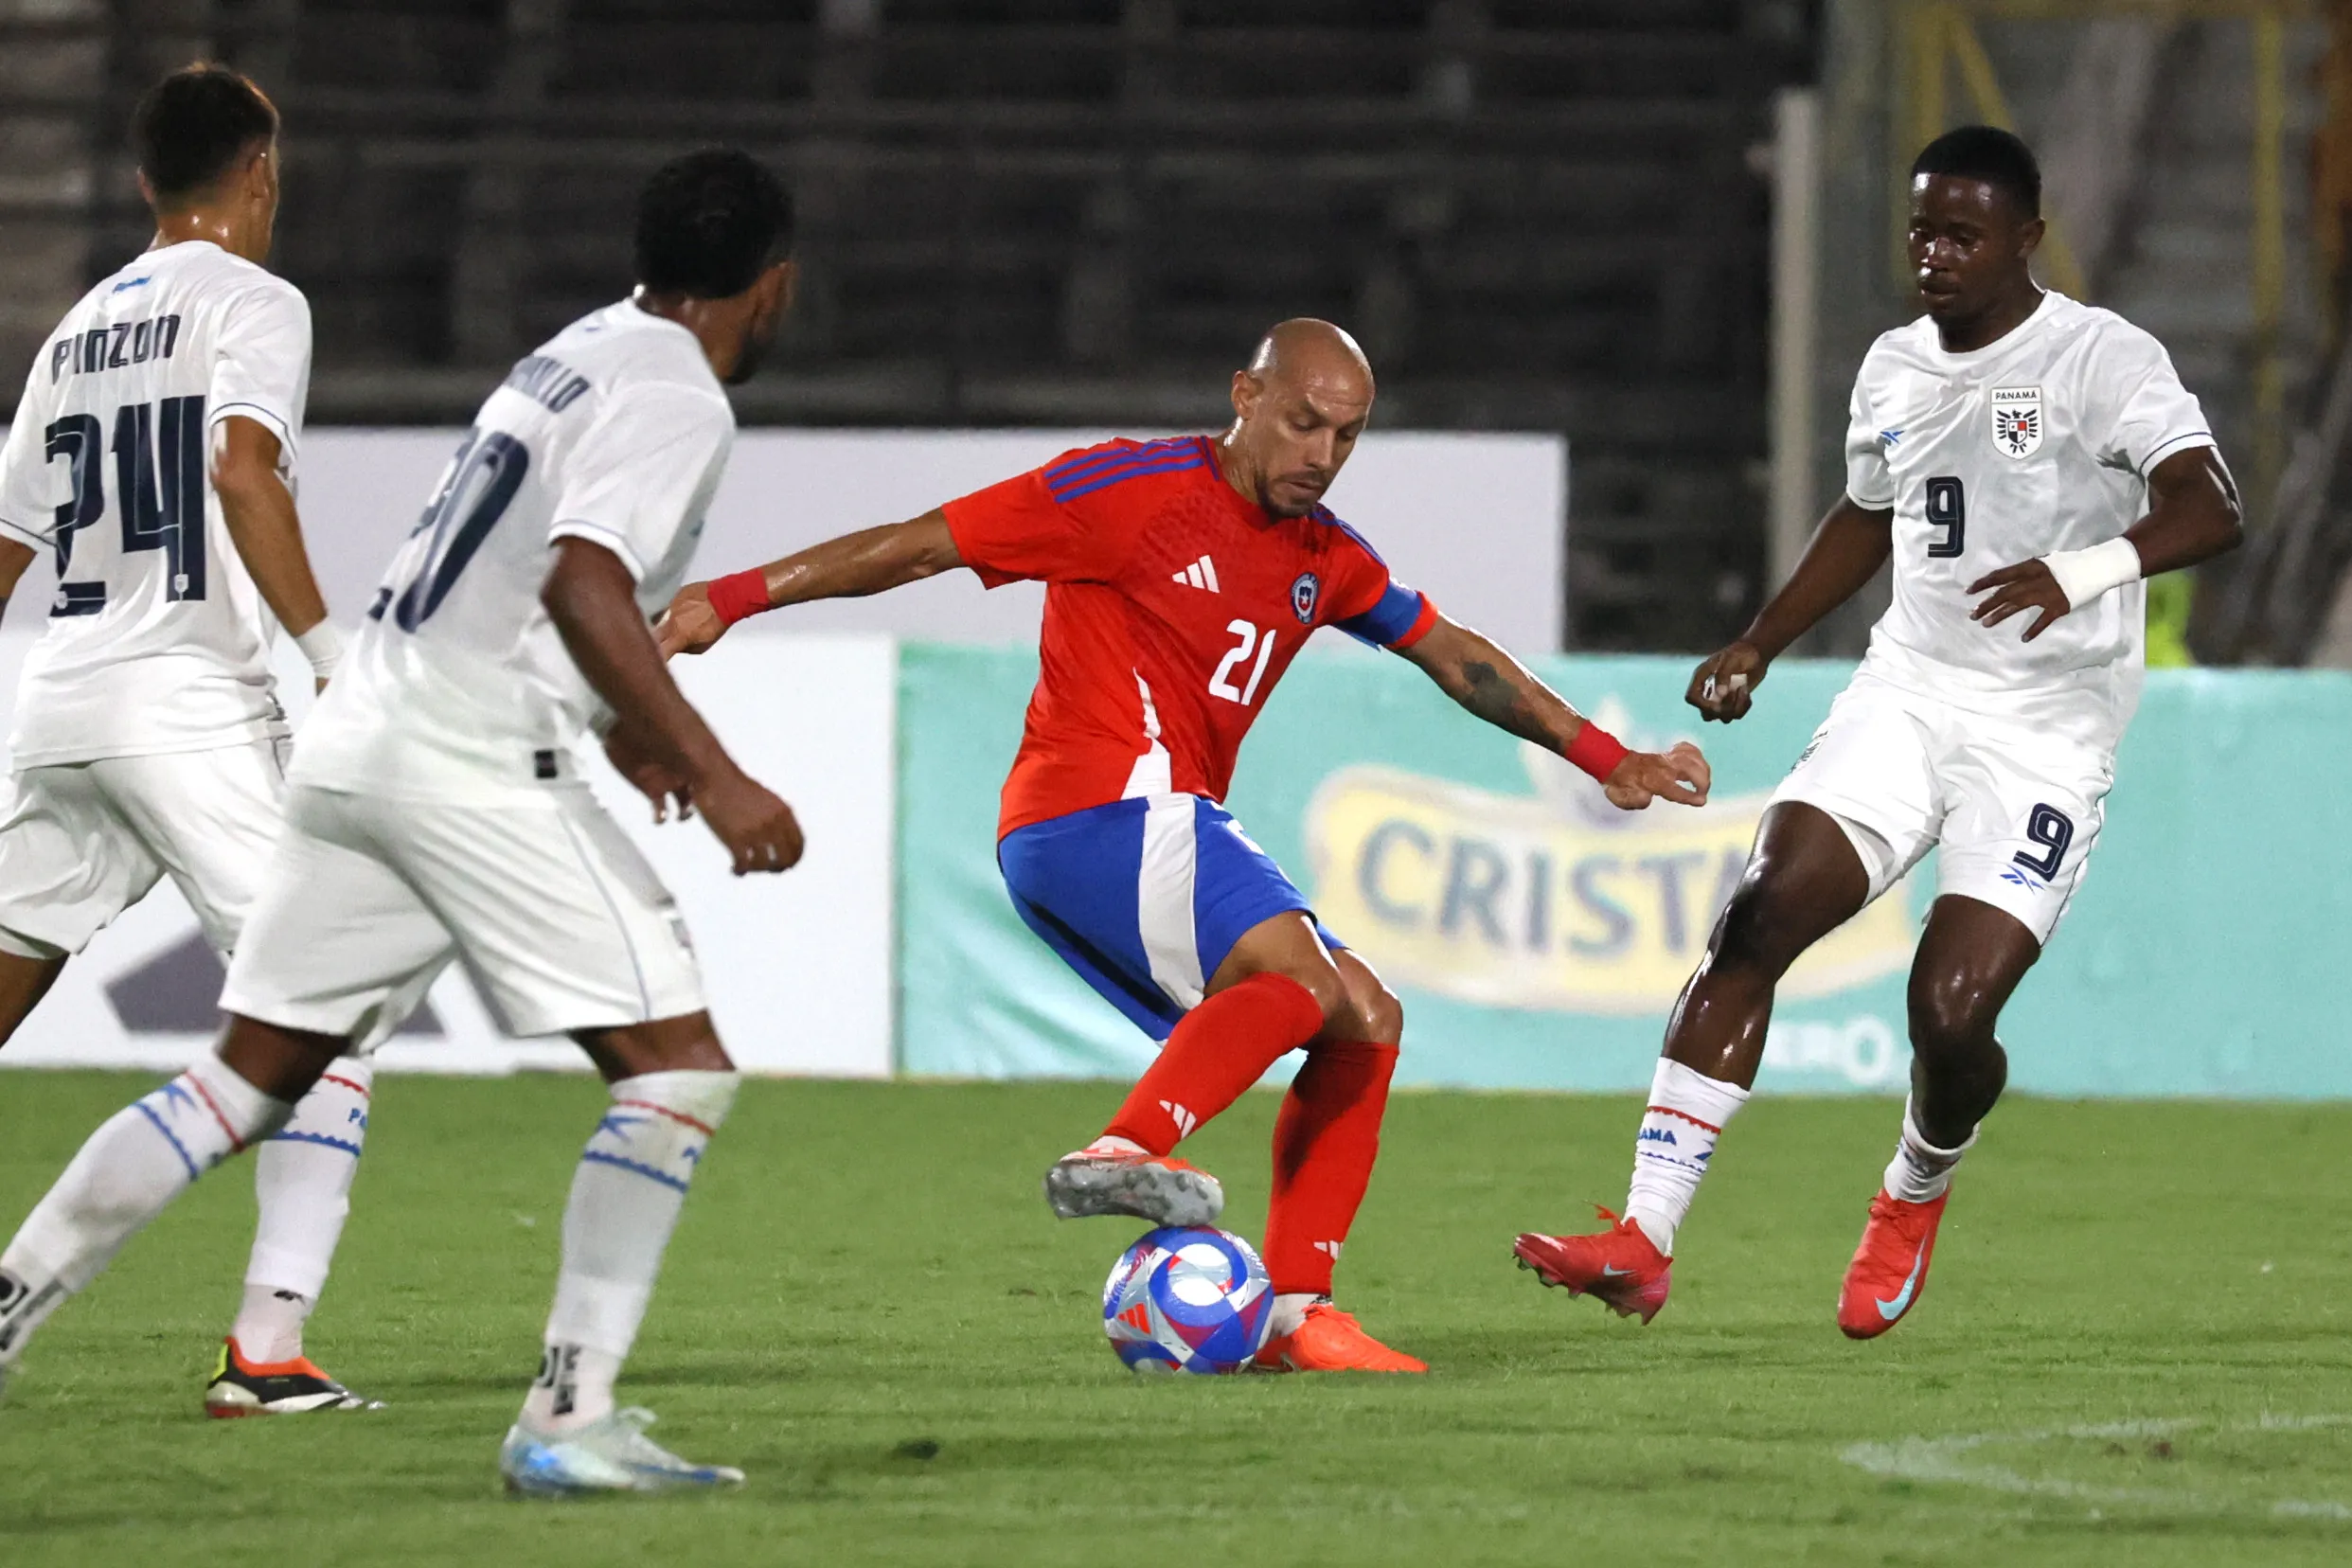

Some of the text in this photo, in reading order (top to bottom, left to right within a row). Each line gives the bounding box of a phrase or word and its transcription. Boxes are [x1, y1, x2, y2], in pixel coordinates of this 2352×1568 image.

[51, 314, 181, 385] PINZON
[45, 395, 205, 617] 24
[1925, 475, 1965, 558] 9
[1208, 618, 1276, 706] 21
[2012, 802, 2074, 882] 9
